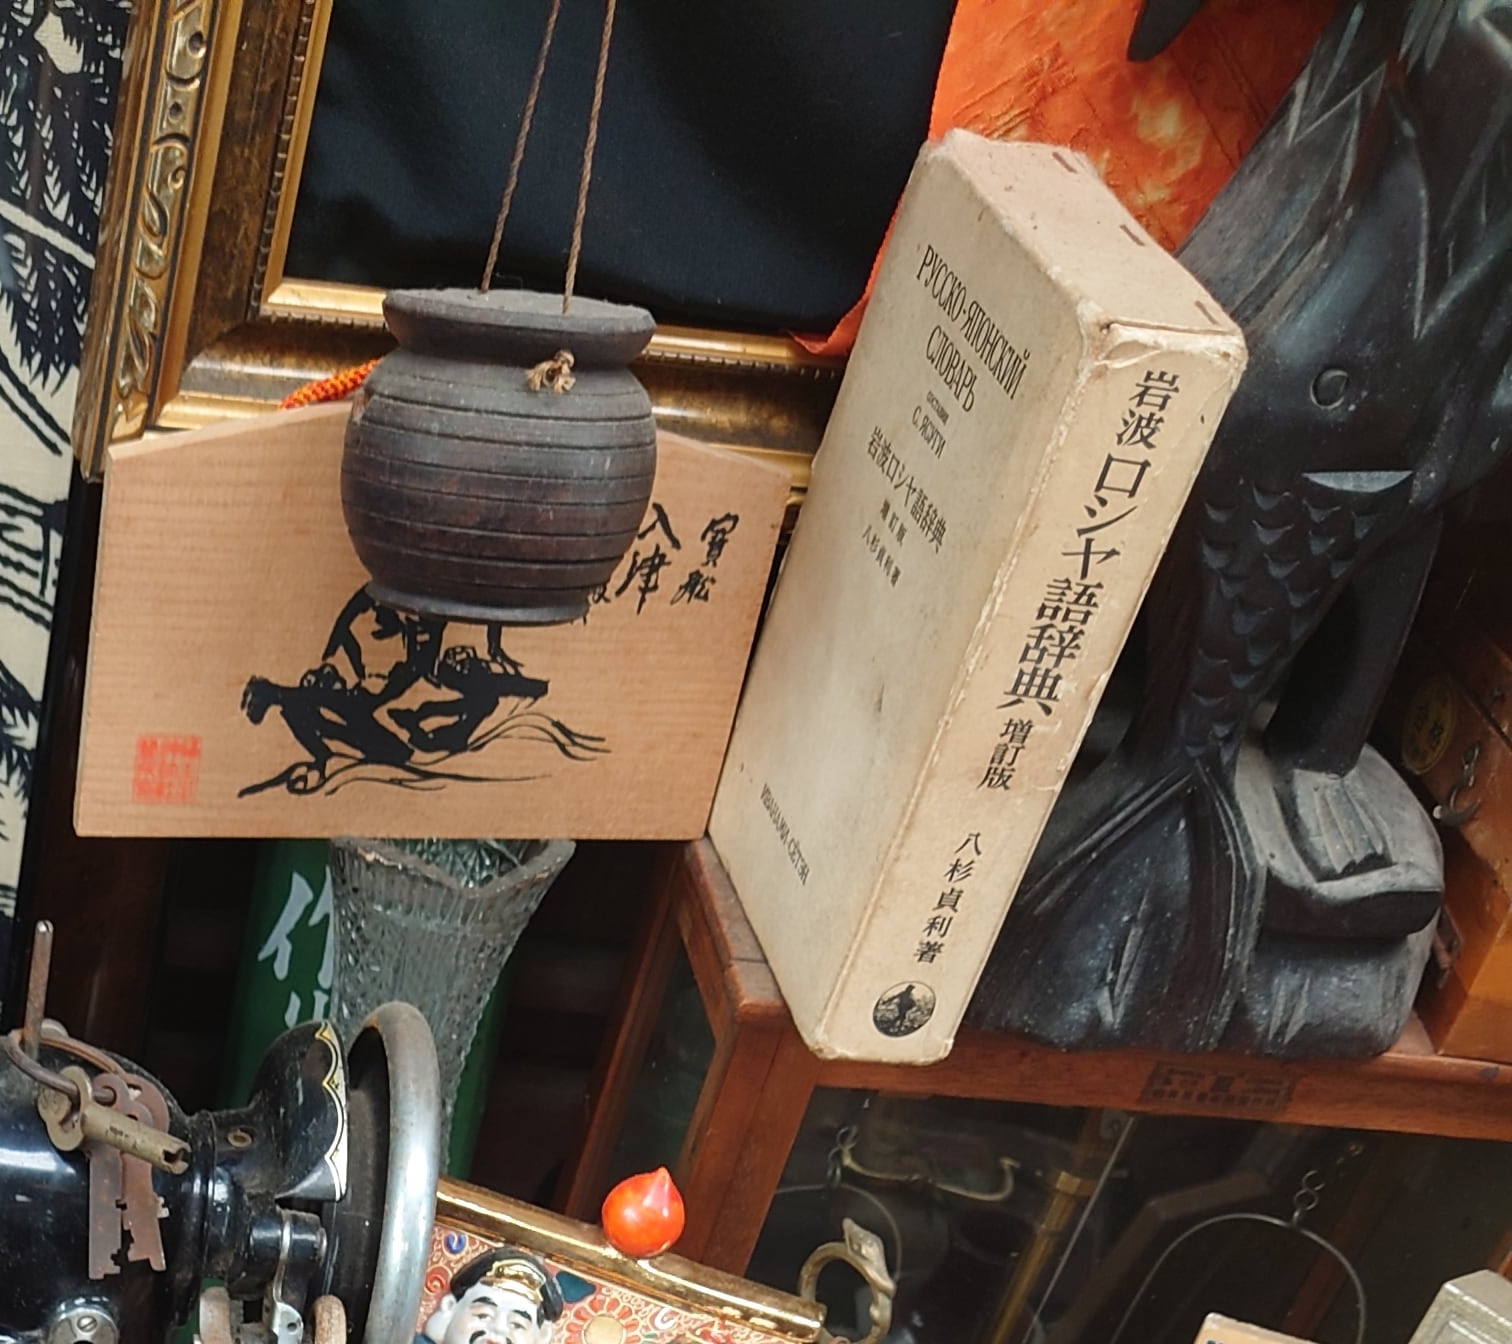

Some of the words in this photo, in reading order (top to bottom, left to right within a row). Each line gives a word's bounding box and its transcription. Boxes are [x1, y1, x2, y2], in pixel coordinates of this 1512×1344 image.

[916, 245, 1031, 401] РУССКО-ЯПОНСКИЙ
[926, 324, 978, 413] СЛОВАРЬ
[977, 717, 1036, 793] 増訂版
[913, 831, 984, 965] 八杉貞利著
